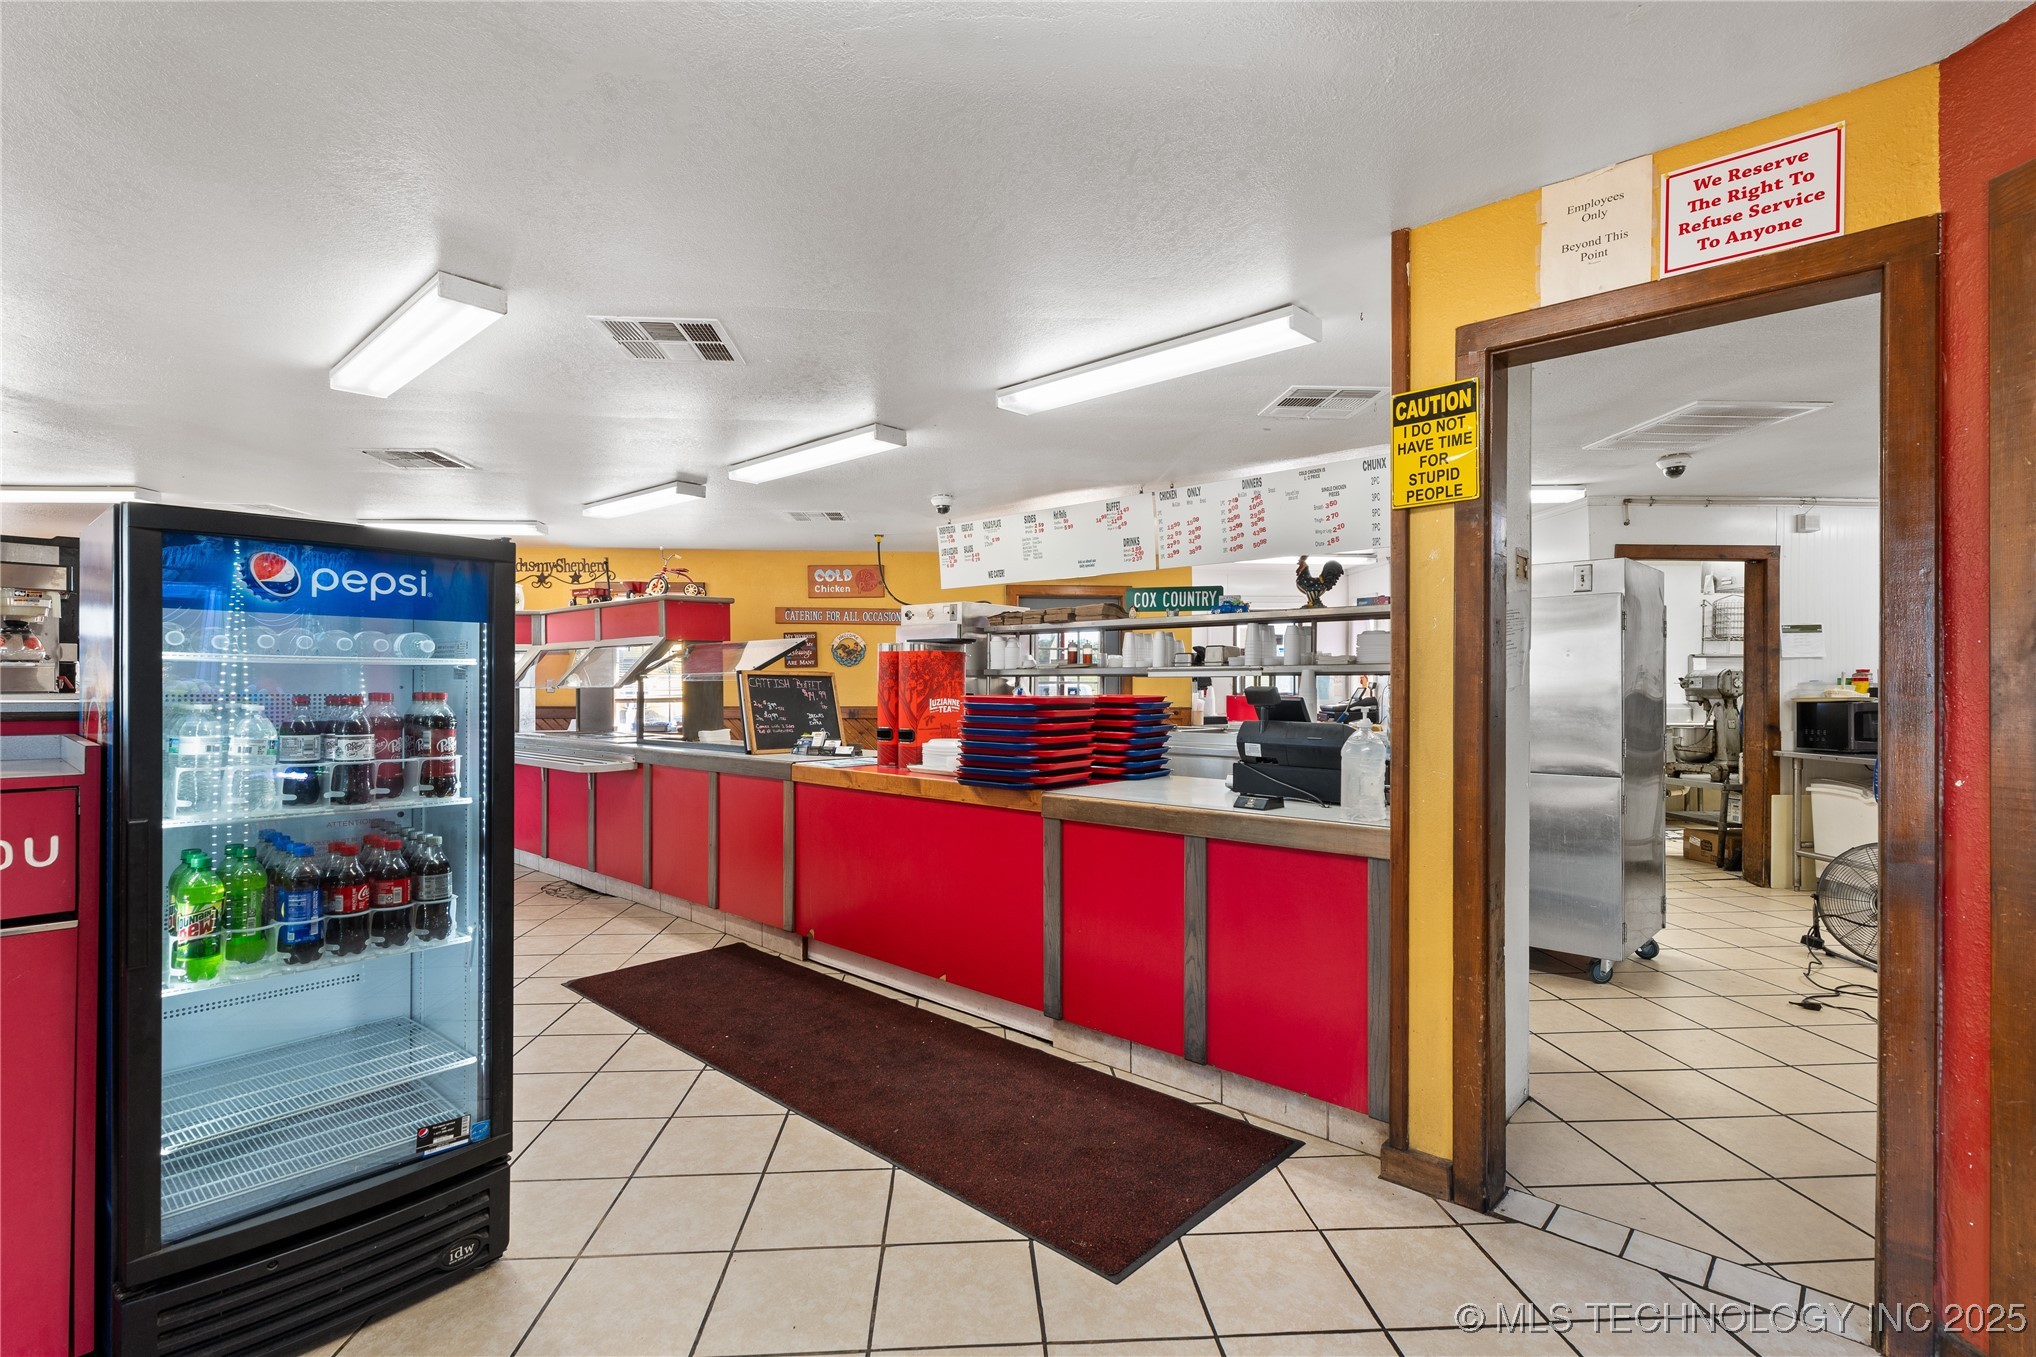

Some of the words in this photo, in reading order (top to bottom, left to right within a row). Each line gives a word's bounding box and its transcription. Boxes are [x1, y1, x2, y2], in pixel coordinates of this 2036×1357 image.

[1693, 174, 1722, 192] We
[1728, 152, 1809, 182] Reserve
[1688, 196, 1722, 213] The
[1728, 178, 1784, 203] Right
[1789, 170, 1815, 186] To
[1567, 192, 1625, 215] Employees
[1582, 209, 1608, 222] Only
[1678, 212, 1743, 236] Refuse
[1748, 190, 1826, 218] Service
[1696, 237, 1720, 251] To
[1725, 217, 1803, 245] Anyone
[1561, 236, 1602, 254] Beyond
[1604, 230, 1629, 243] This
[1580, 249, 1608, 262] Point
[1396, 388, 1472, 420] CAUTION
[1404, 427, 1406, 438] I
[1412, 422, 1432, 437] DO
[1436, 416, 1466, 432] NOT
[1398, 438, 1434, 456] HAVE
[1438, 432, 1472, 448] TIME
[1362, 457, 1386, 472] CHUNX
[1420, 452, 1448, 468] FOR
[1242, 477, 1262, 490] DINNERS
[1371, 476, 1380, 486] 2PC
[1408, 467, 1460, 486] STUPID
[1159, 490, 1177, 501] CHICKEN
[1187, 486, 1201, 498] ONLY
[1371, 492, 1380, 502] 3PC
[1406, 484, 1462, 502] PEOPLE
[1106, 501, 1120, 512] BUFFET
[1024, 514, 1036, 524] SIDES
[1123, 537, 1140, 547] DRINKS
[814, 569, 852, 582] COLD
[988, 570, 993, 579] WE
[312, 568, 428, 601] pepsi
[814, 585, 851, 593] Chicken
[1134, 592, 1157, 608] COX
[1163, 590, 1217, 607] COUNTRY
[784, 610, 822, 621] CATERING
[826, 611, 840, 621] FOR
[843, 611, 860, 621] ALL
[748, 678, 790, 688] CATFISH
[929, 698, 960, 710] LUZIANNE
[450, 1243, 475, 1262] idw
